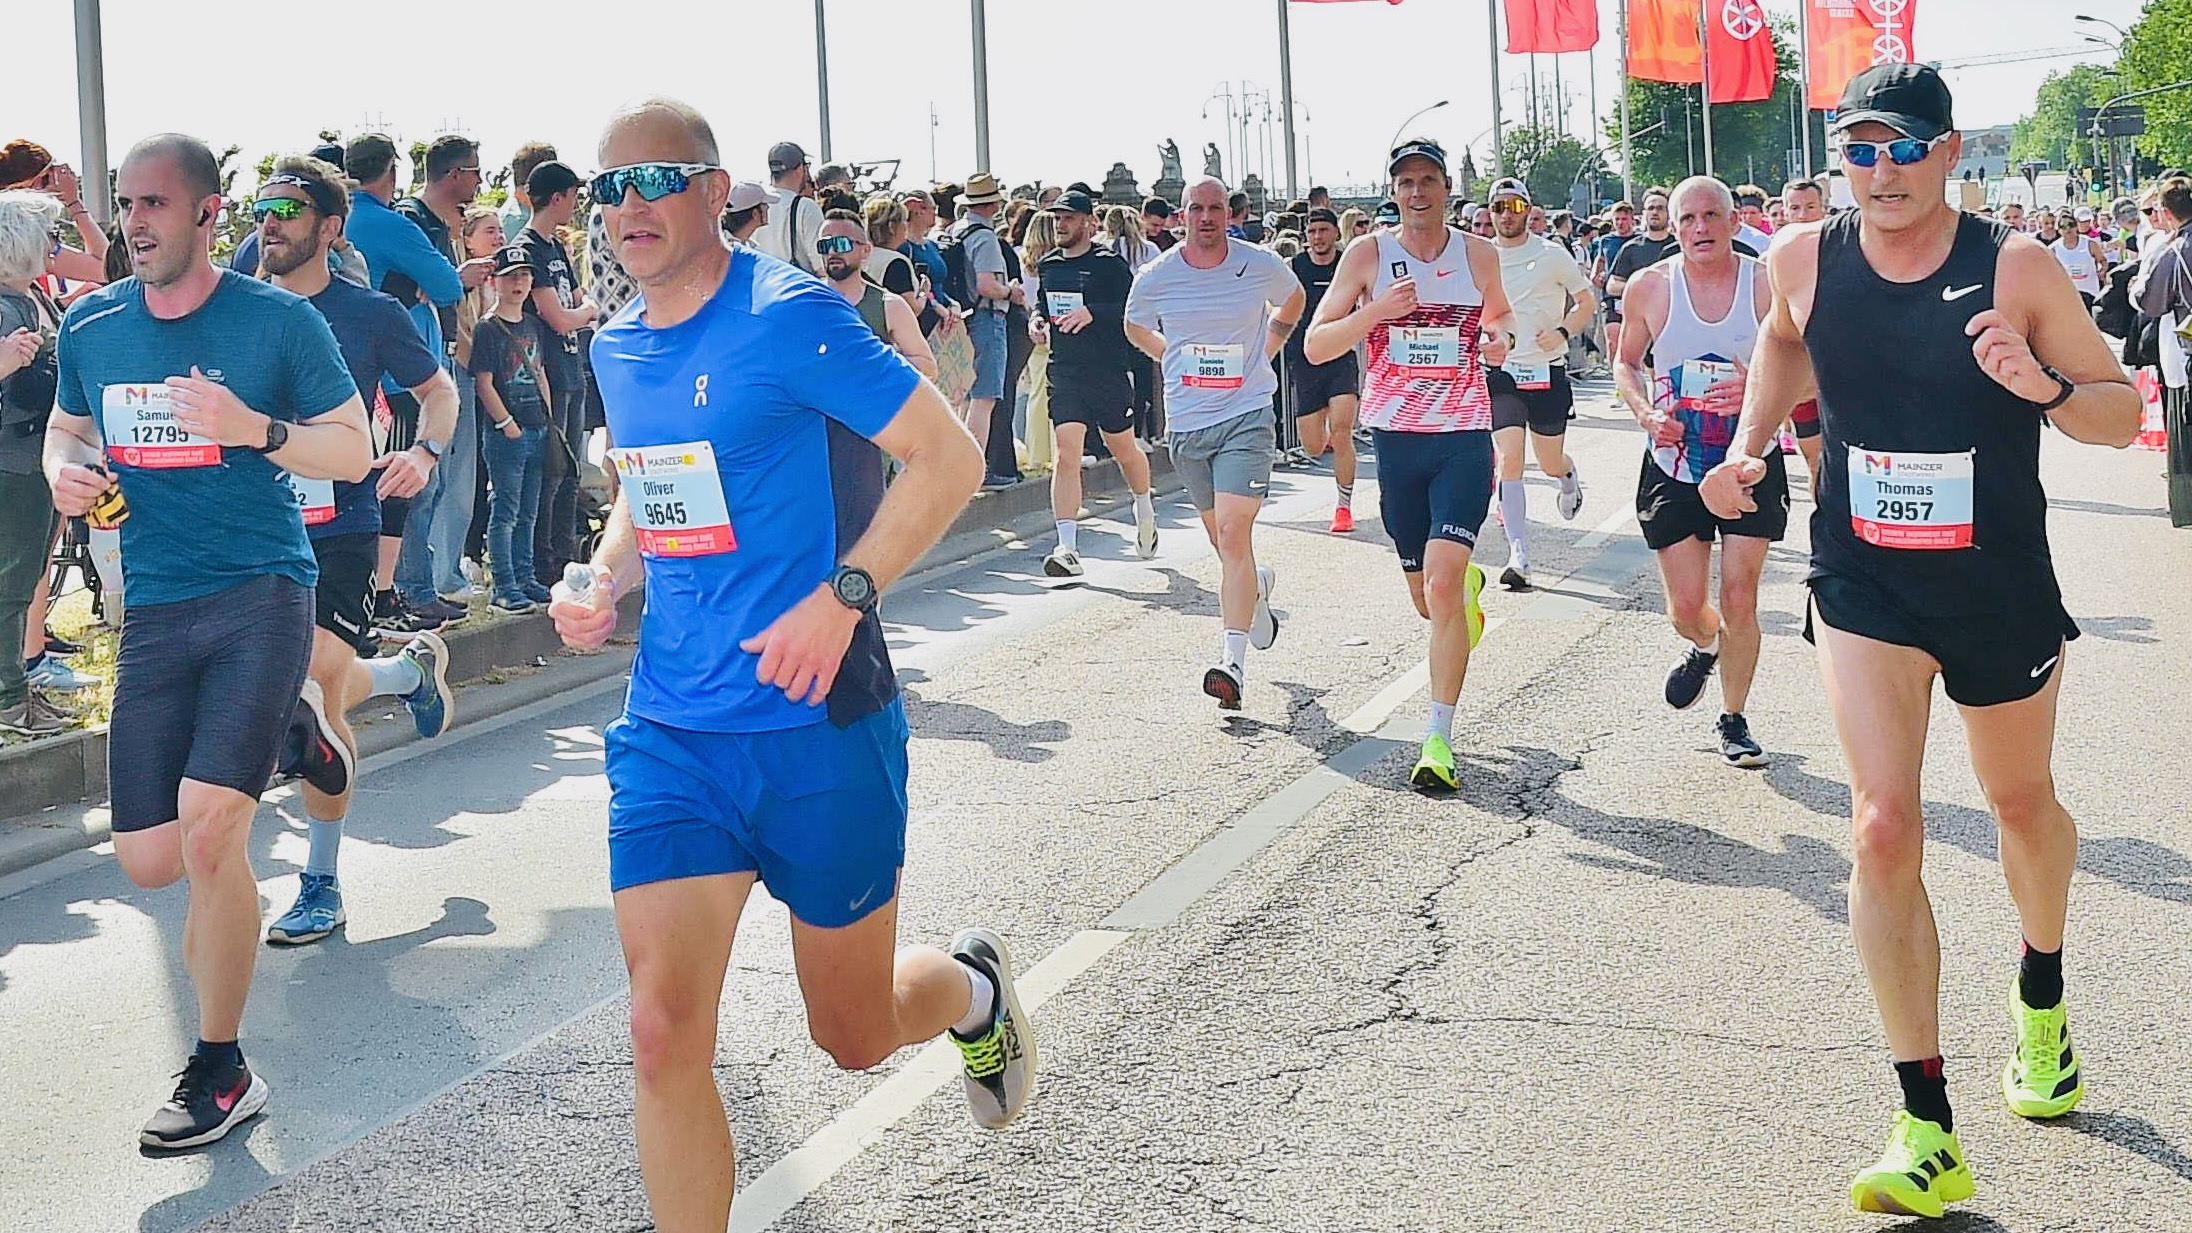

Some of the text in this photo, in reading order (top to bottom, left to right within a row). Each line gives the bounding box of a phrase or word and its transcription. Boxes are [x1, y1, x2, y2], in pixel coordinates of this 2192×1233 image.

[1408, 343, 1439, 351] Michael
[1408, 353, 1440, 364] 2567
[1199, 366, 1226, 376] 9898
[131, 425, 189, 443] 12795
[1897, 463, 1944, 472] MAINZER
[643, 481, 675, 496] Oliver
[1875, 480, 1935, 496] Thomas
[644, 501, 688, 525] 9645
[1876, 499, 1935, 521] 2957
